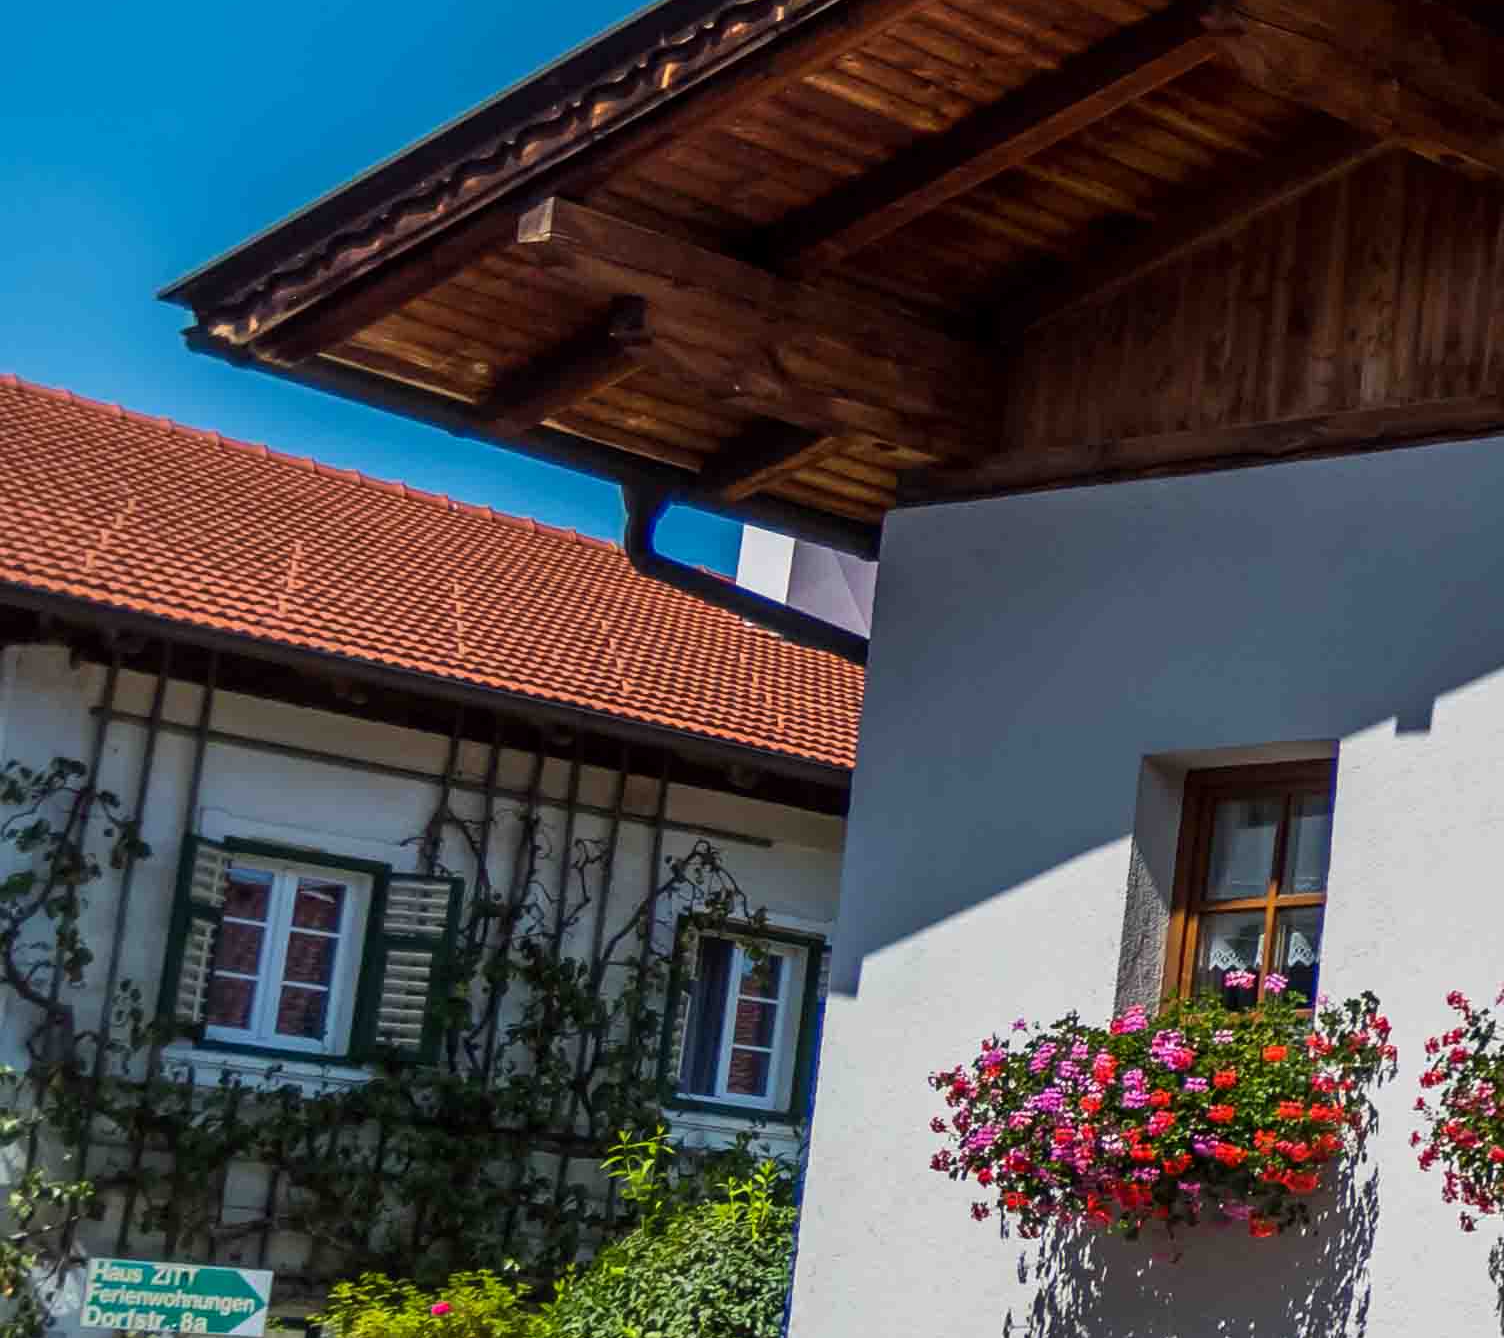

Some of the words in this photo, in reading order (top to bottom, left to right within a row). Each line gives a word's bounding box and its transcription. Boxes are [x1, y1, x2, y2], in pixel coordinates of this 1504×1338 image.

[92, 1259, 143, 1284] Haus
[151, 1264, 199, 1287] ZITT
[87, 1282, 256, 1315] Ferienwohnungen
[179, 1311, 208, 1334] 8a
